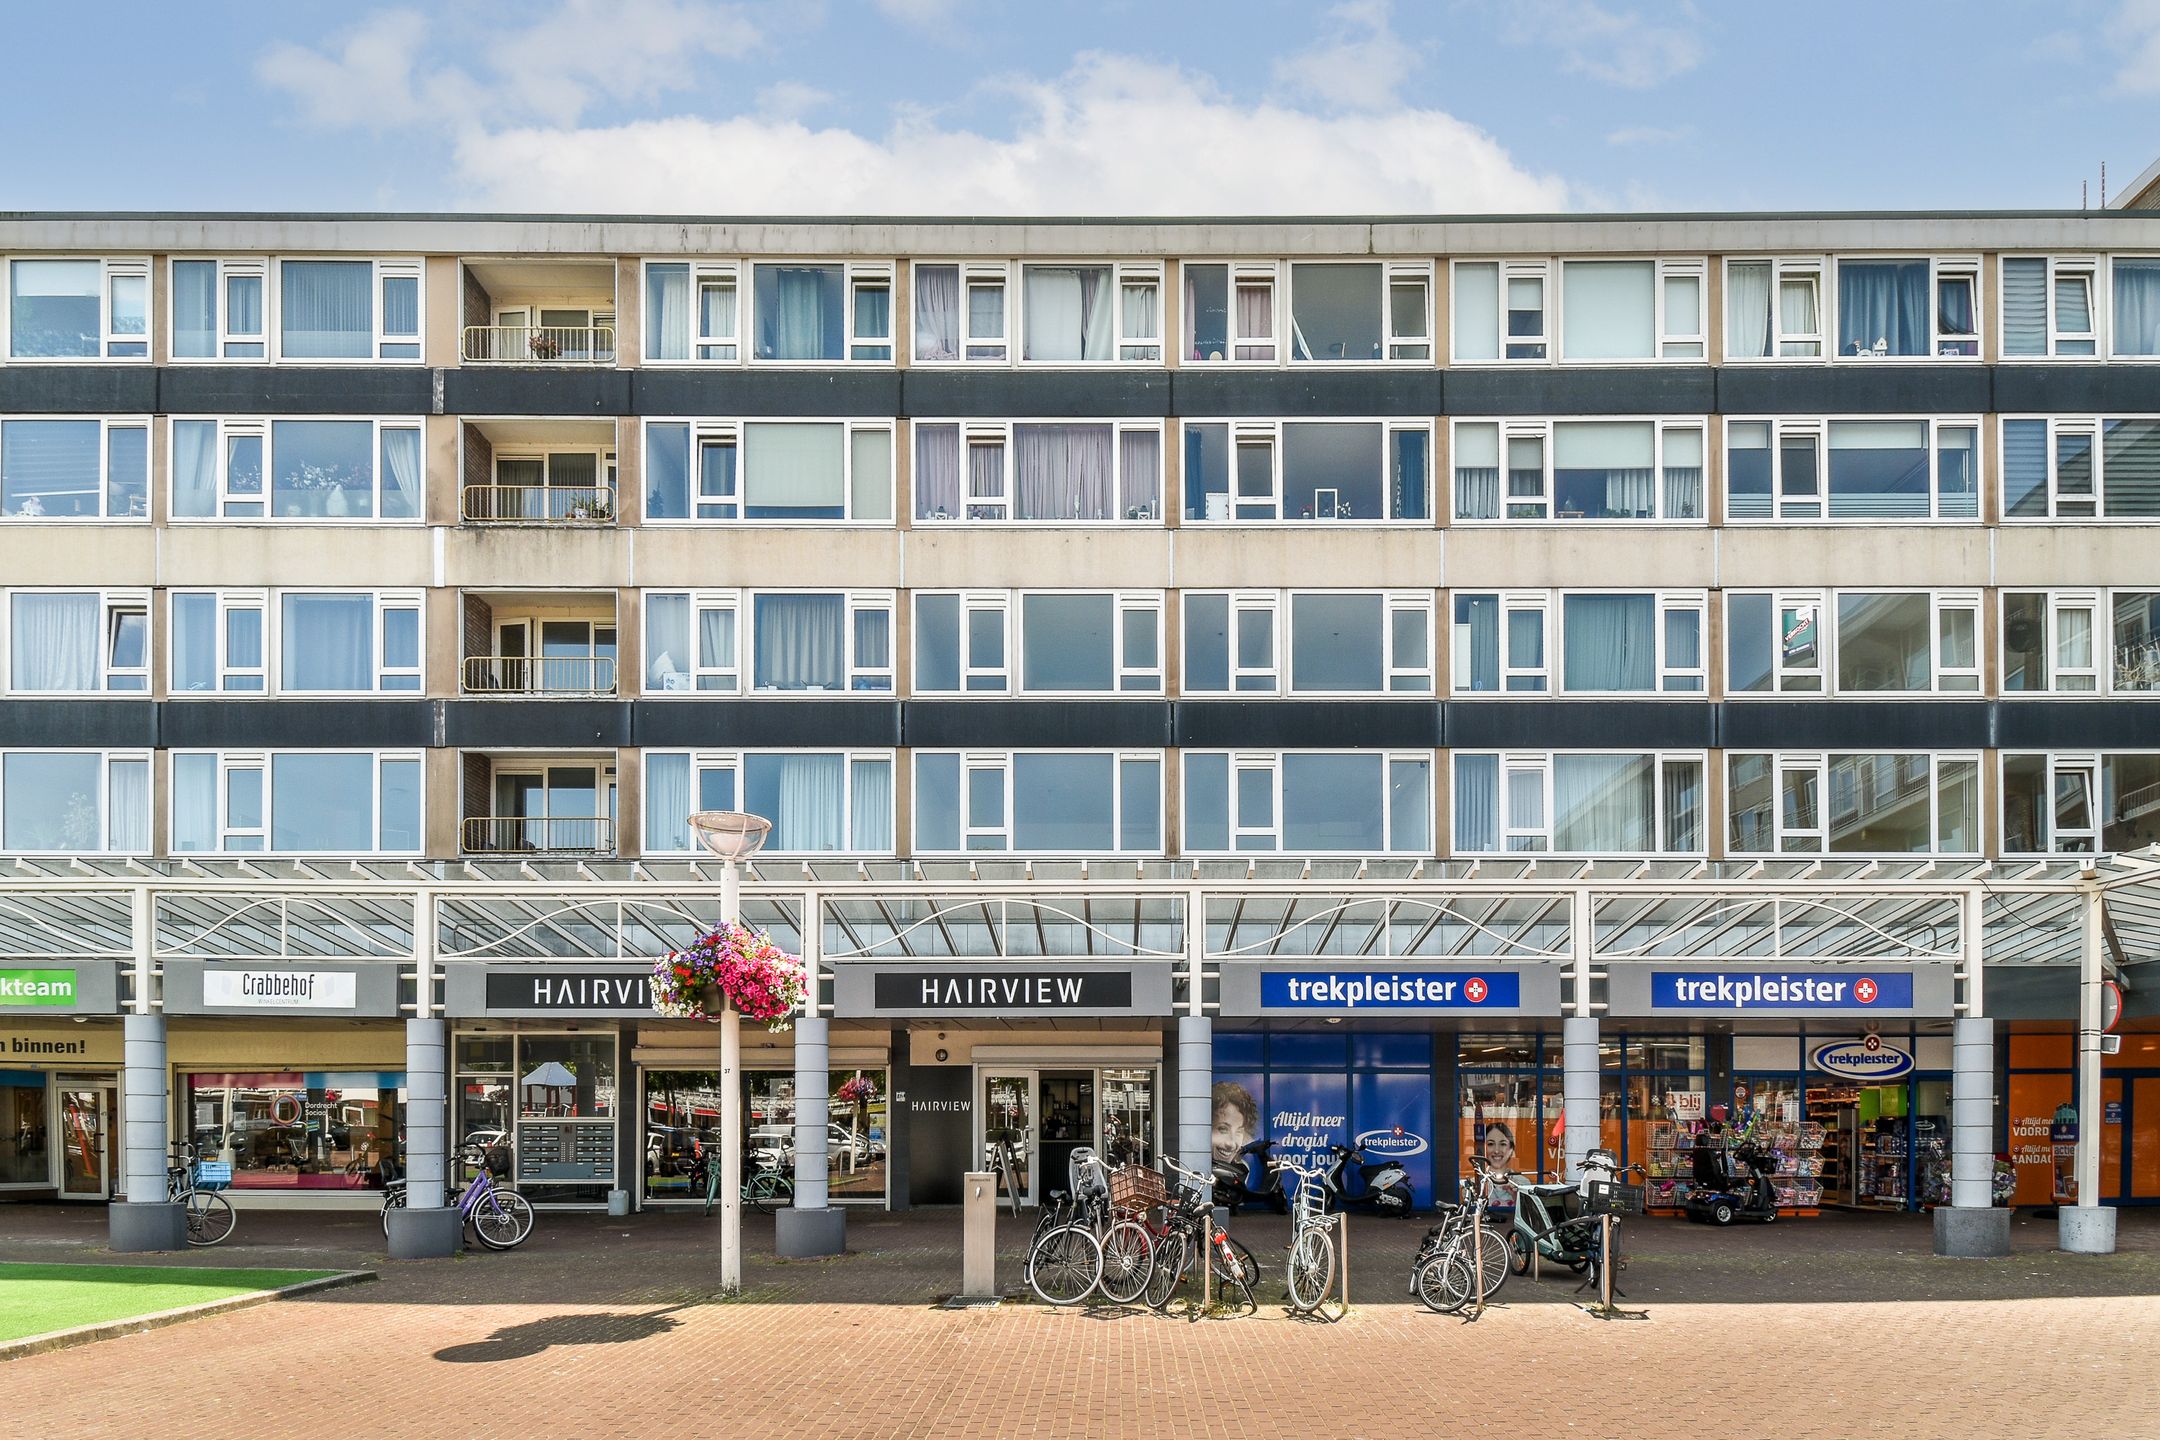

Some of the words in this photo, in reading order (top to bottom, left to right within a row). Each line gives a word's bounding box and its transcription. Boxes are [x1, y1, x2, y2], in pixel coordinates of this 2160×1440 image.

[243, 973, 315, 1000] Crabbehof
[534, 979, 655, 1004] HAIRVI
[922, 978, 1083, 1004] HAIRVIEW
[1288, 975, 1457, 1007] trekpleister
[1675, 975, 1847, 1007] trekpleister
[12, 1038, 85, 1053] binnen!
[1828, 1053, 1901, 1067] trekpleister
[911, 1101, 971, 1111] HAIRVIEW
[1680, 1094, 1701, 1110] blij
[1272, 1111, 1310, 1131] Altijd
[1311, 1115, 1345, 1127] meer
[1281, 1132, 1329, 1151] drogist
[1364, 1137, 1418, 1149] trekpleister
